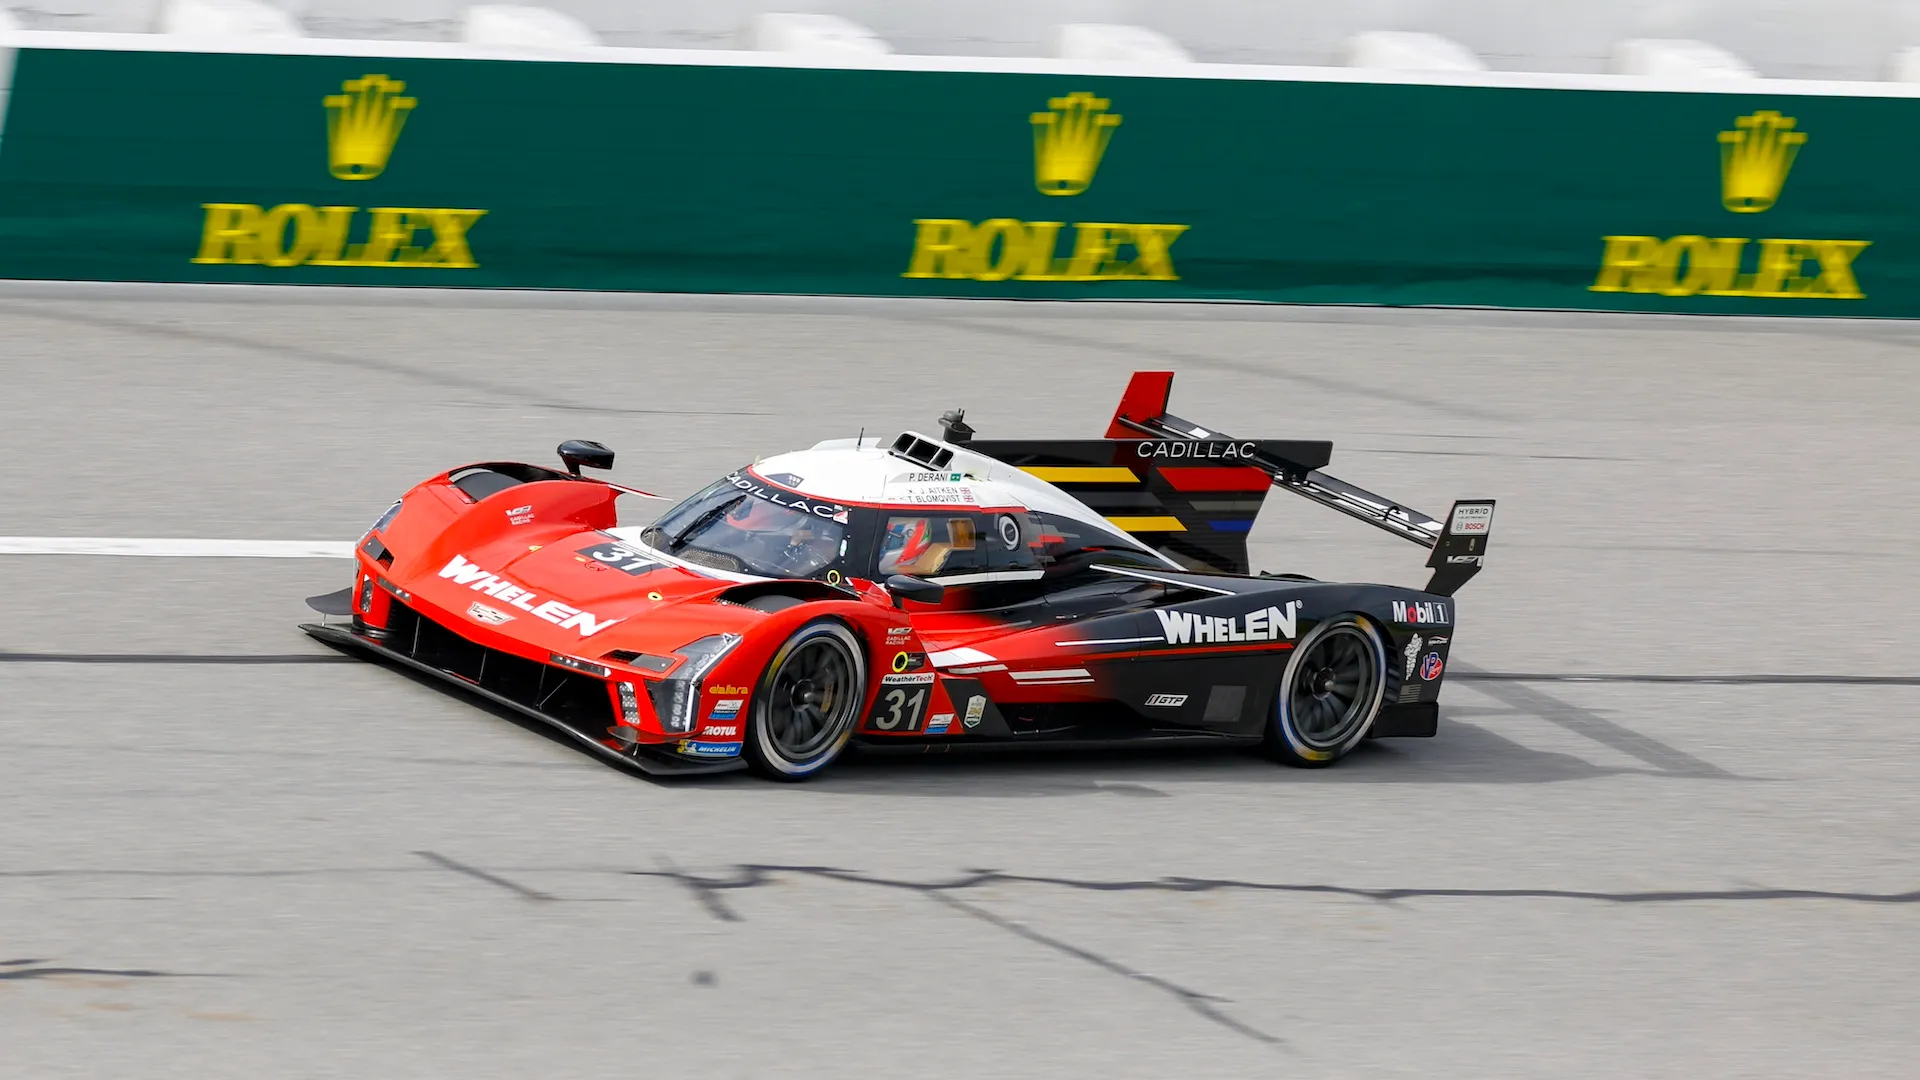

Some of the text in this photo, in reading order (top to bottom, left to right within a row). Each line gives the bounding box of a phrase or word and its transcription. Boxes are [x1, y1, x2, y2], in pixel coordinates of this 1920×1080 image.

[189, 203, 489, 268] ROLEX
[901, 218, 1190, 281] ROLEX
[1587, 235, 1873, 298] ROLEX
[1137, 441, 1256, 458] CADILLAC
[909, 473, 948, 481] P. DERANI
[916, 495, 961, 503] BLOMQVIST
[1465, 522, 1485, 530] BOSCH
[593, 547, 659, 572] 31
[438, 554, 620, 637] WHELEN
[1154, 600, 1297, 644] WHELEN
[1392, 601, 1445, 624] Mobil 1
[709, 684, 749, 695] dallara
[876, 688, 926, 730] 31
[702, 726, 737, 736] MOTUL
